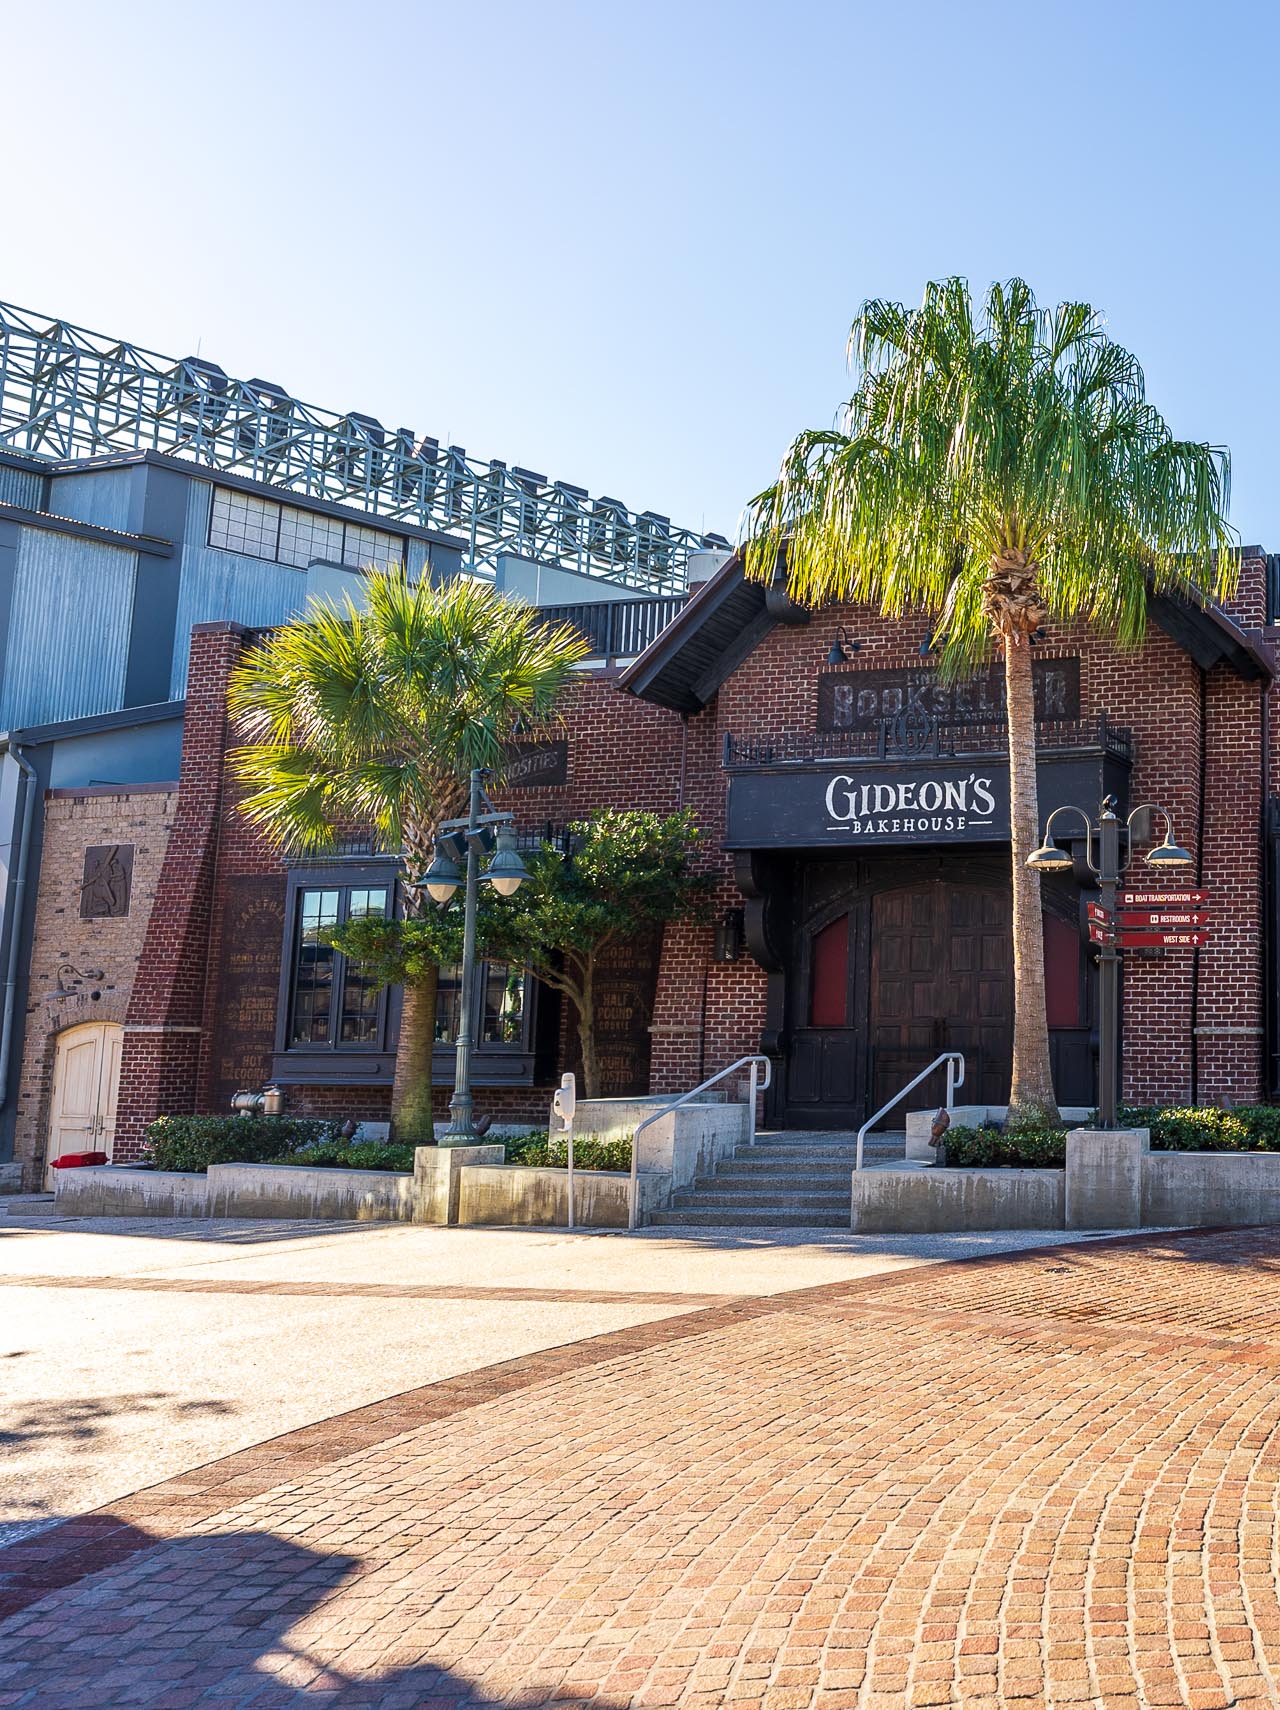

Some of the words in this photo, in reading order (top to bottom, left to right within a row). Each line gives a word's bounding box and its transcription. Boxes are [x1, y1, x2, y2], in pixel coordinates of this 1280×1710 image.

[825, 773, 996, 821] GIDEON'S
[852, 817, 966, 834] BAKEHOUSE
[1135, 894, 1148, 902] BOAT
[1148, 894, 1191, 902] TRANSPORTATION
[1160, 915, 1191, 923] RESTROOMS
[1163, 935, 1178, 944] WEST
[1179, 935, 1190, 943] SIDE
